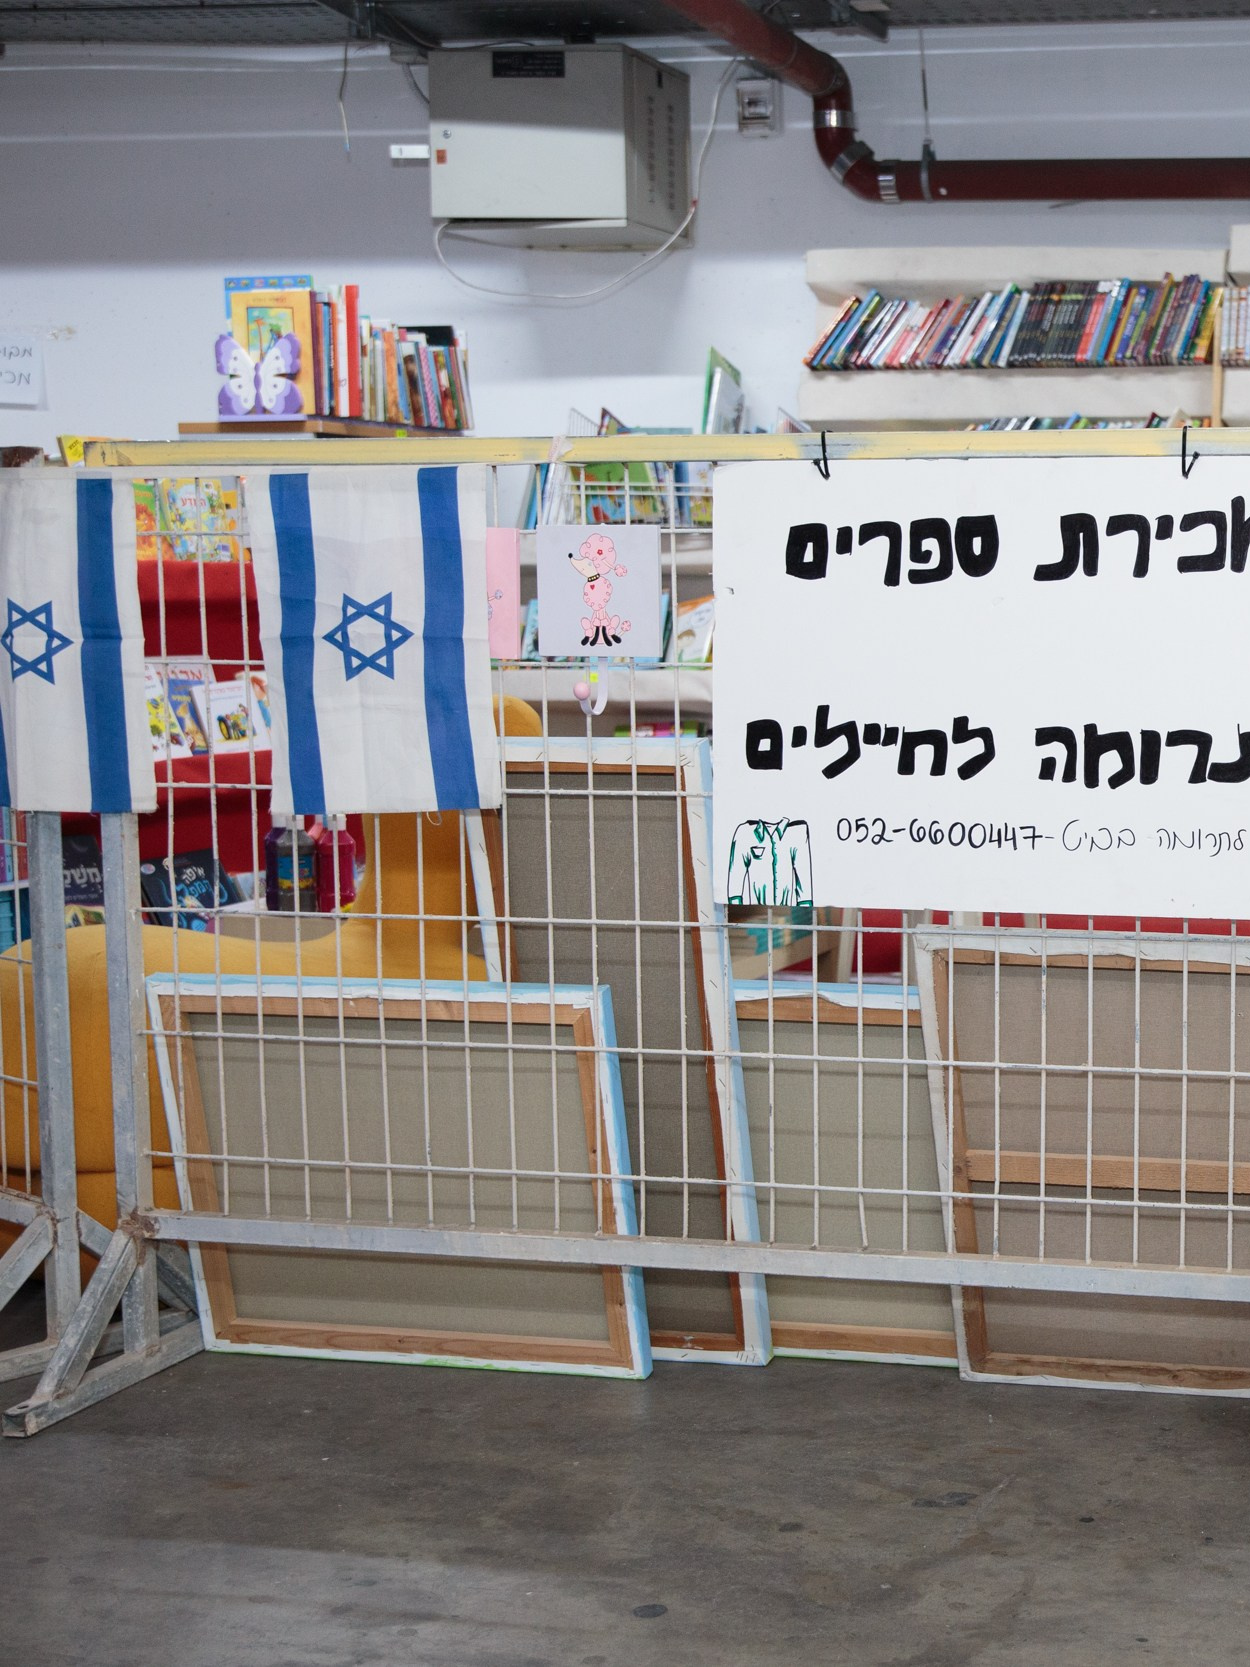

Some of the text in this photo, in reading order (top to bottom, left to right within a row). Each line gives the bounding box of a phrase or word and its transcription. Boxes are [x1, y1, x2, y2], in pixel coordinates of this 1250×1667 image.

[785, 514, 1000, 587] ספרים
[745, 705, 996, 780] לחיילים
[1156, 828, 1247, 857] לתרומה
